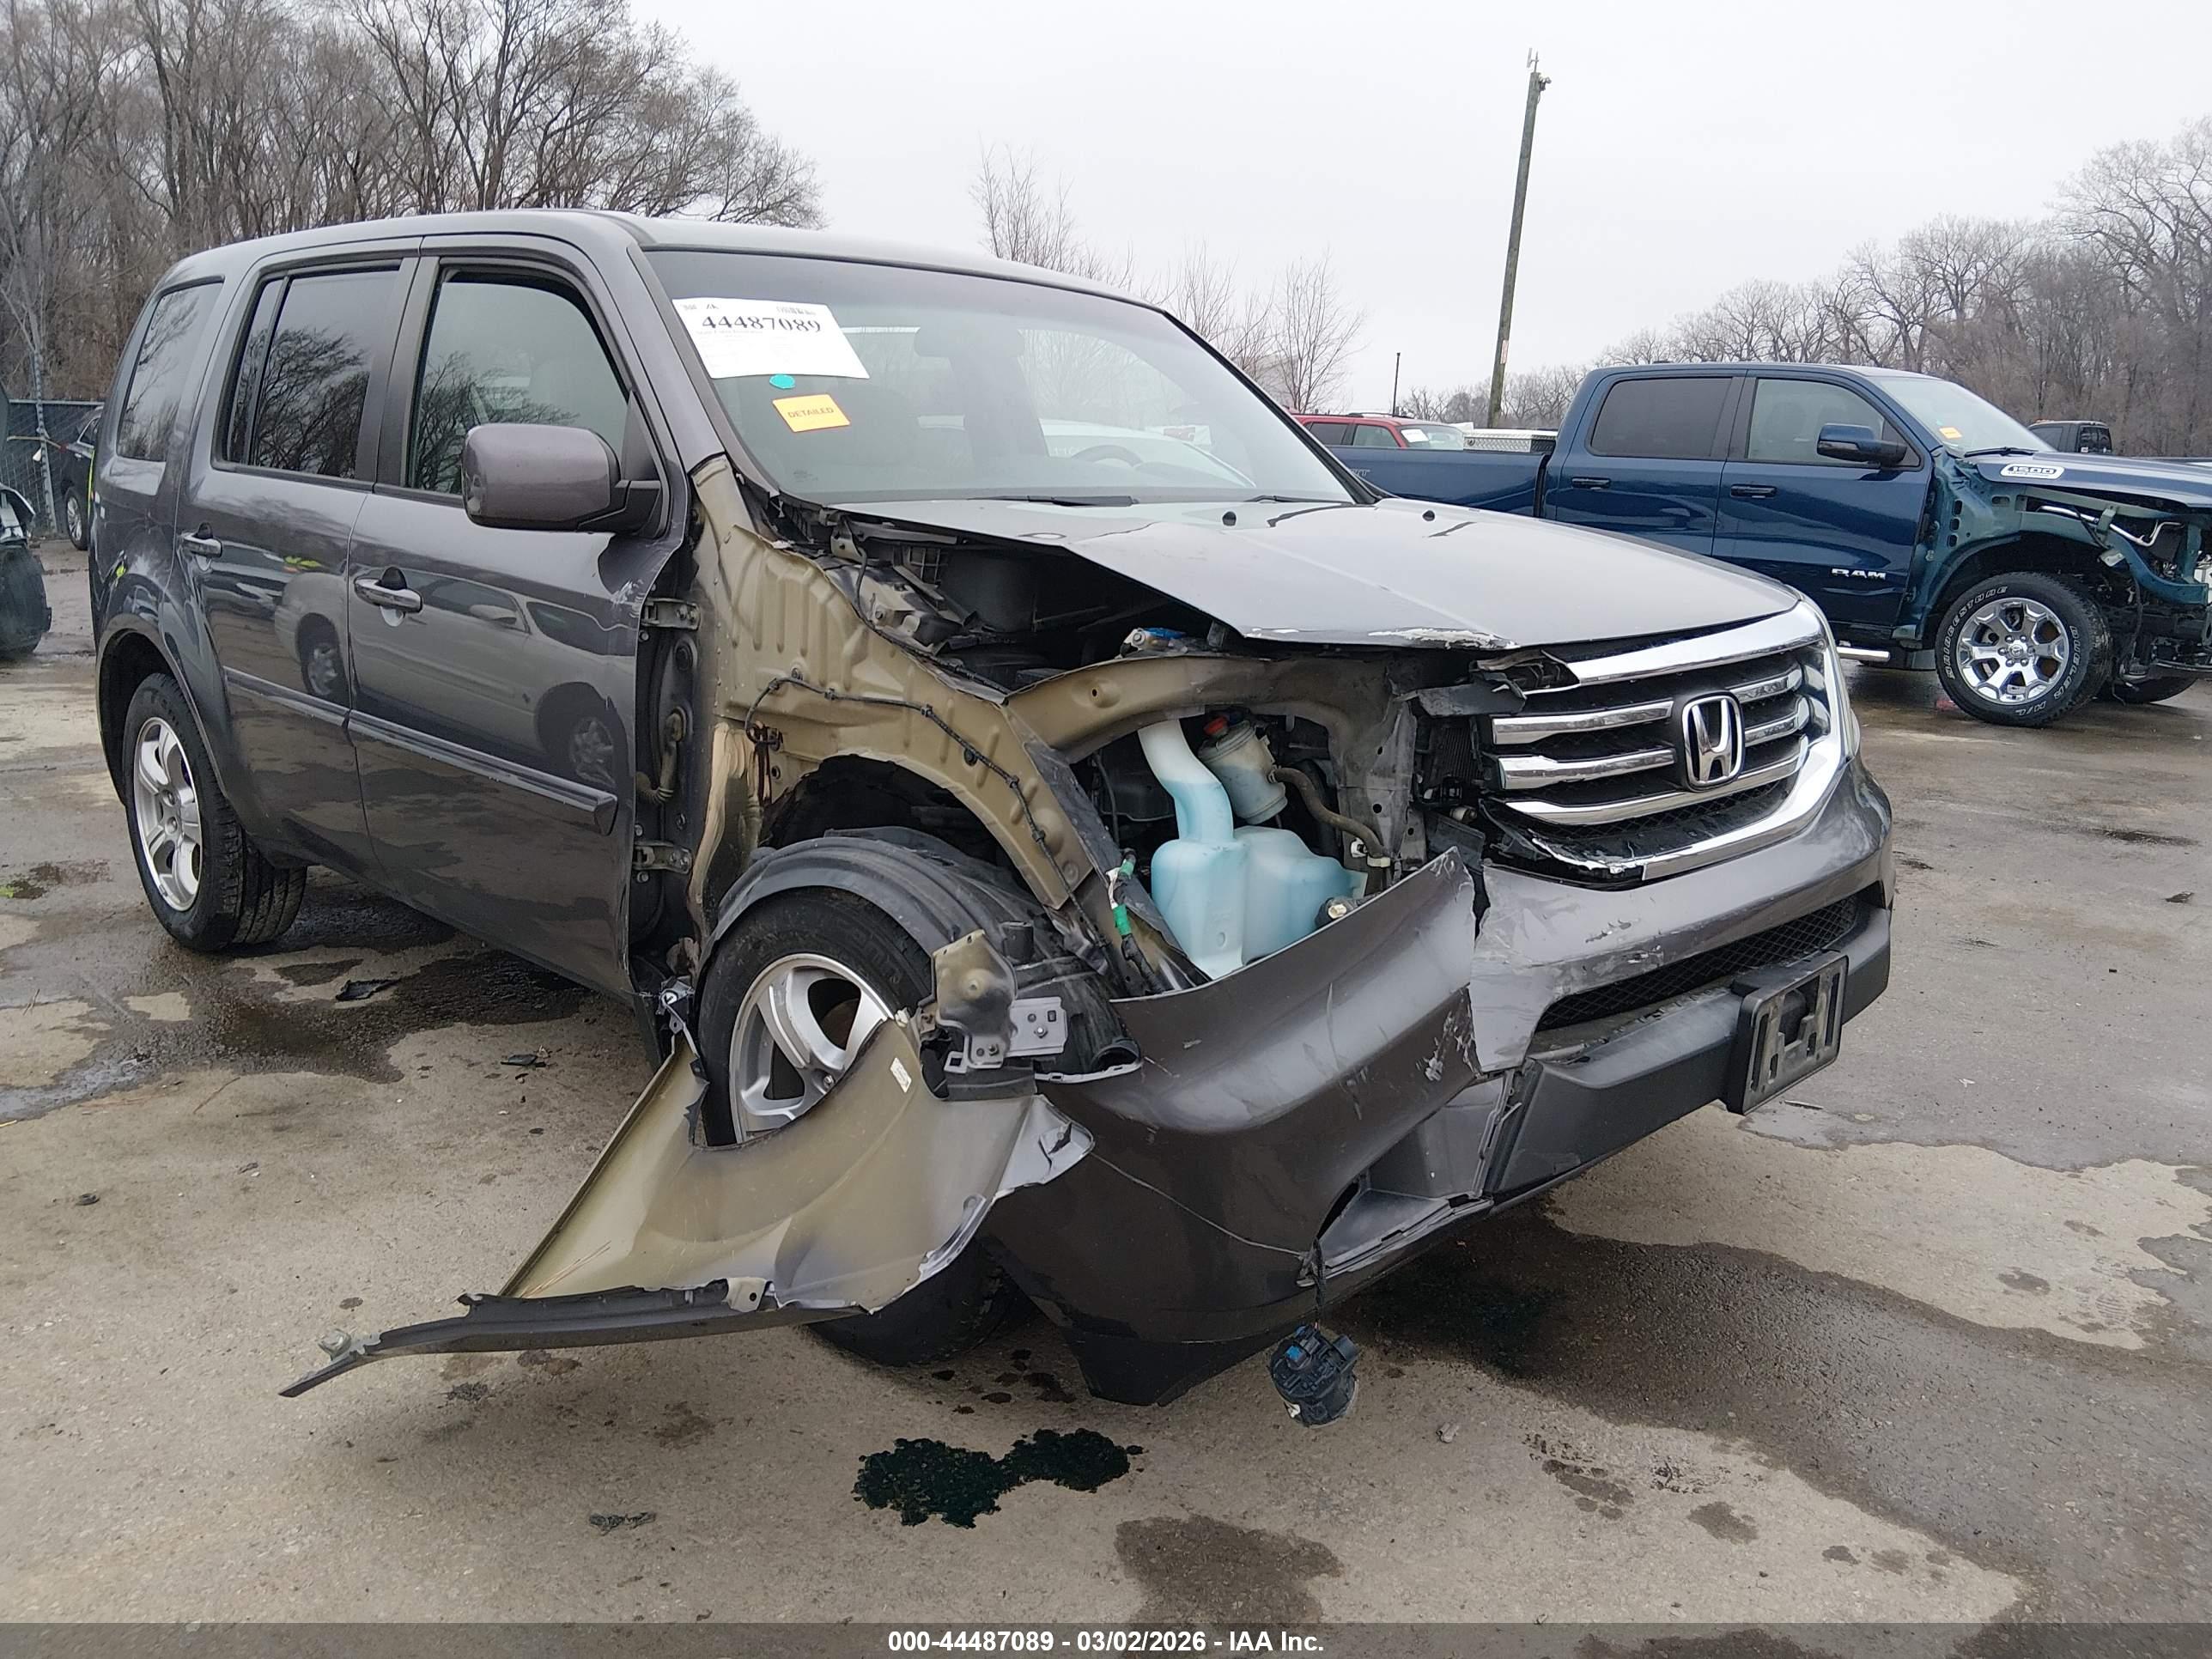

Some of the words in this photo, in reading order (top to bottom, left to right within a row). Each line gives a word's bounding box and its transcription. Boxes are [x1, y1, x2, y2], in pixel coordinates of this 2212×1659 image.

[702, 316, 821, 332] 44487089
[787, 407, 834, 418] DETAILED
[2012, 465, 2056, 475] 1500
[1832, 568, 1887, 580] RAM
[1943, 586, 2008, 680] BRIDGESTONE
